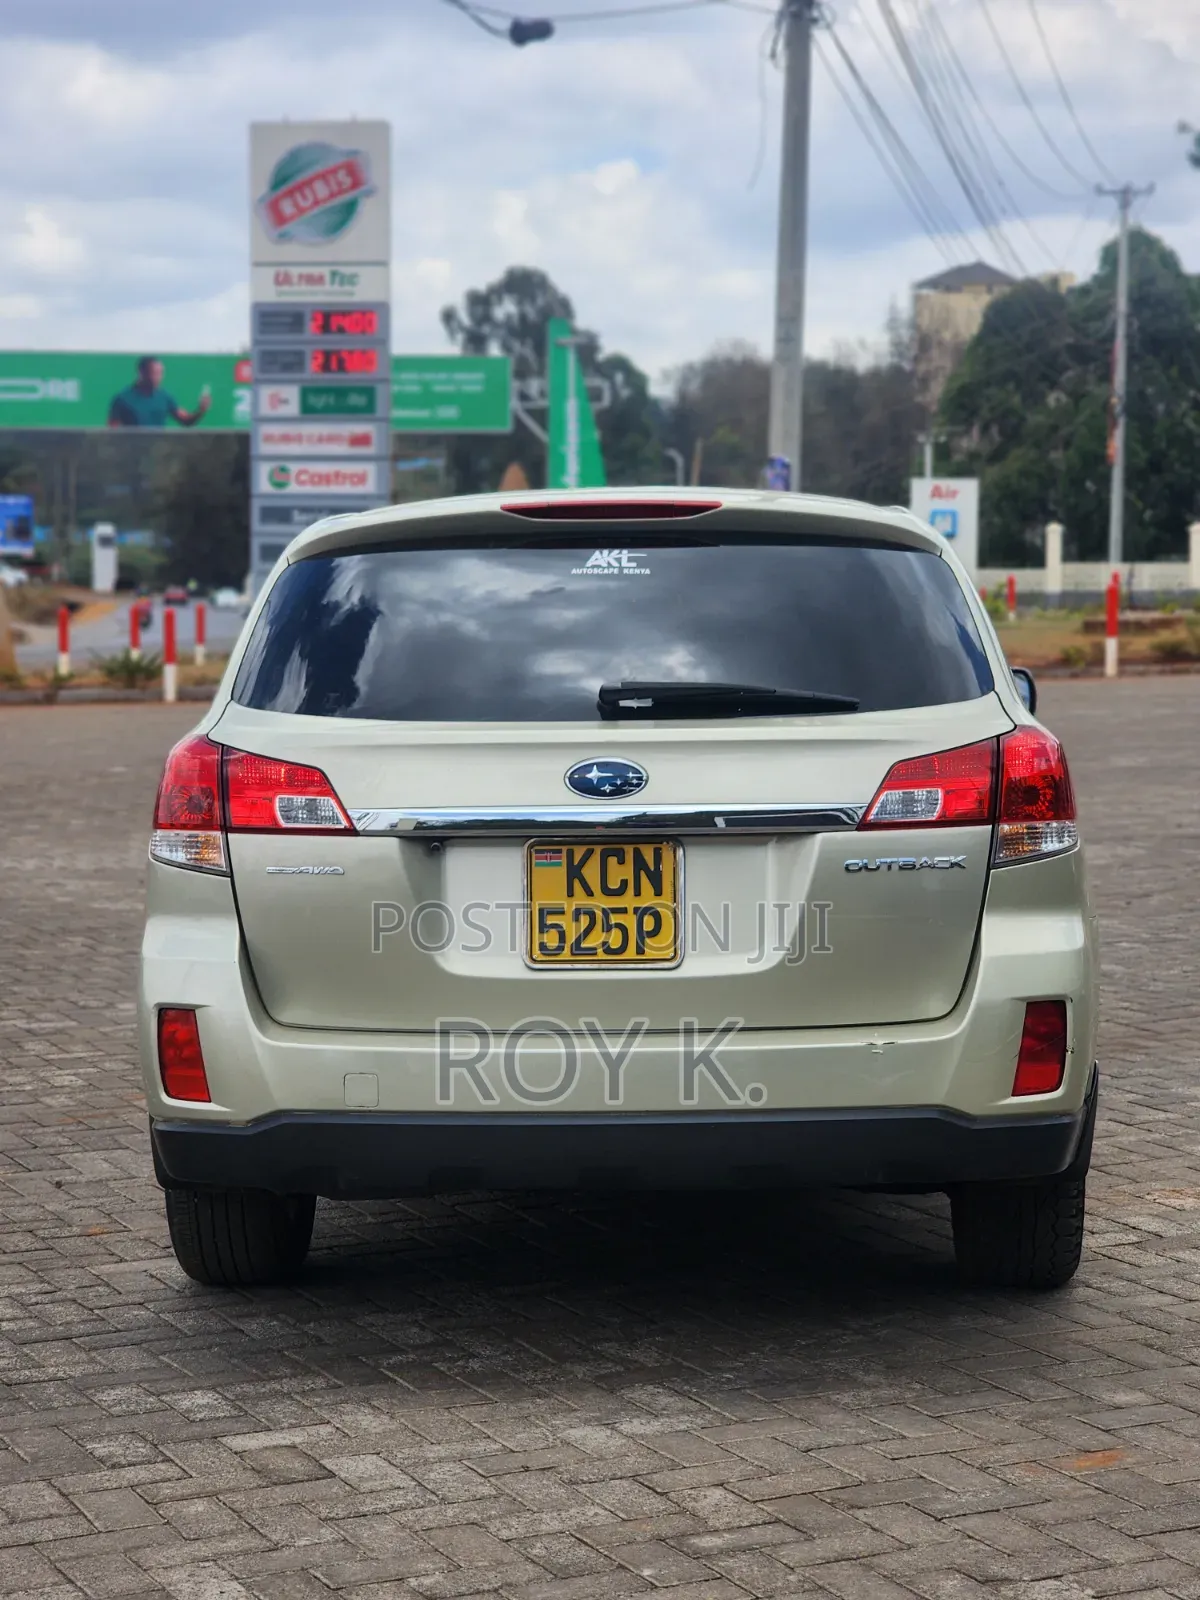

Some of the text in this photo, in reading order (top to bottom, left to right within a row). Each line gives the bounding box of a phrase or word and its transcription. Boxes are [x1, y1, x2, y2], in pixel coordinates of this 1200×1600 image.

[276, 166, 354, 219] RUBIS
[294, 468, 367, 488] Castrol
[930, 484, 959, 501] Air
[571, 567, 651, 575] AUTOSCAPE KENYA
[566, 846, 663, 898] KCN
[843, 855, 967, 873] OUTBACK
[538, 906, 663, 956] 525P
